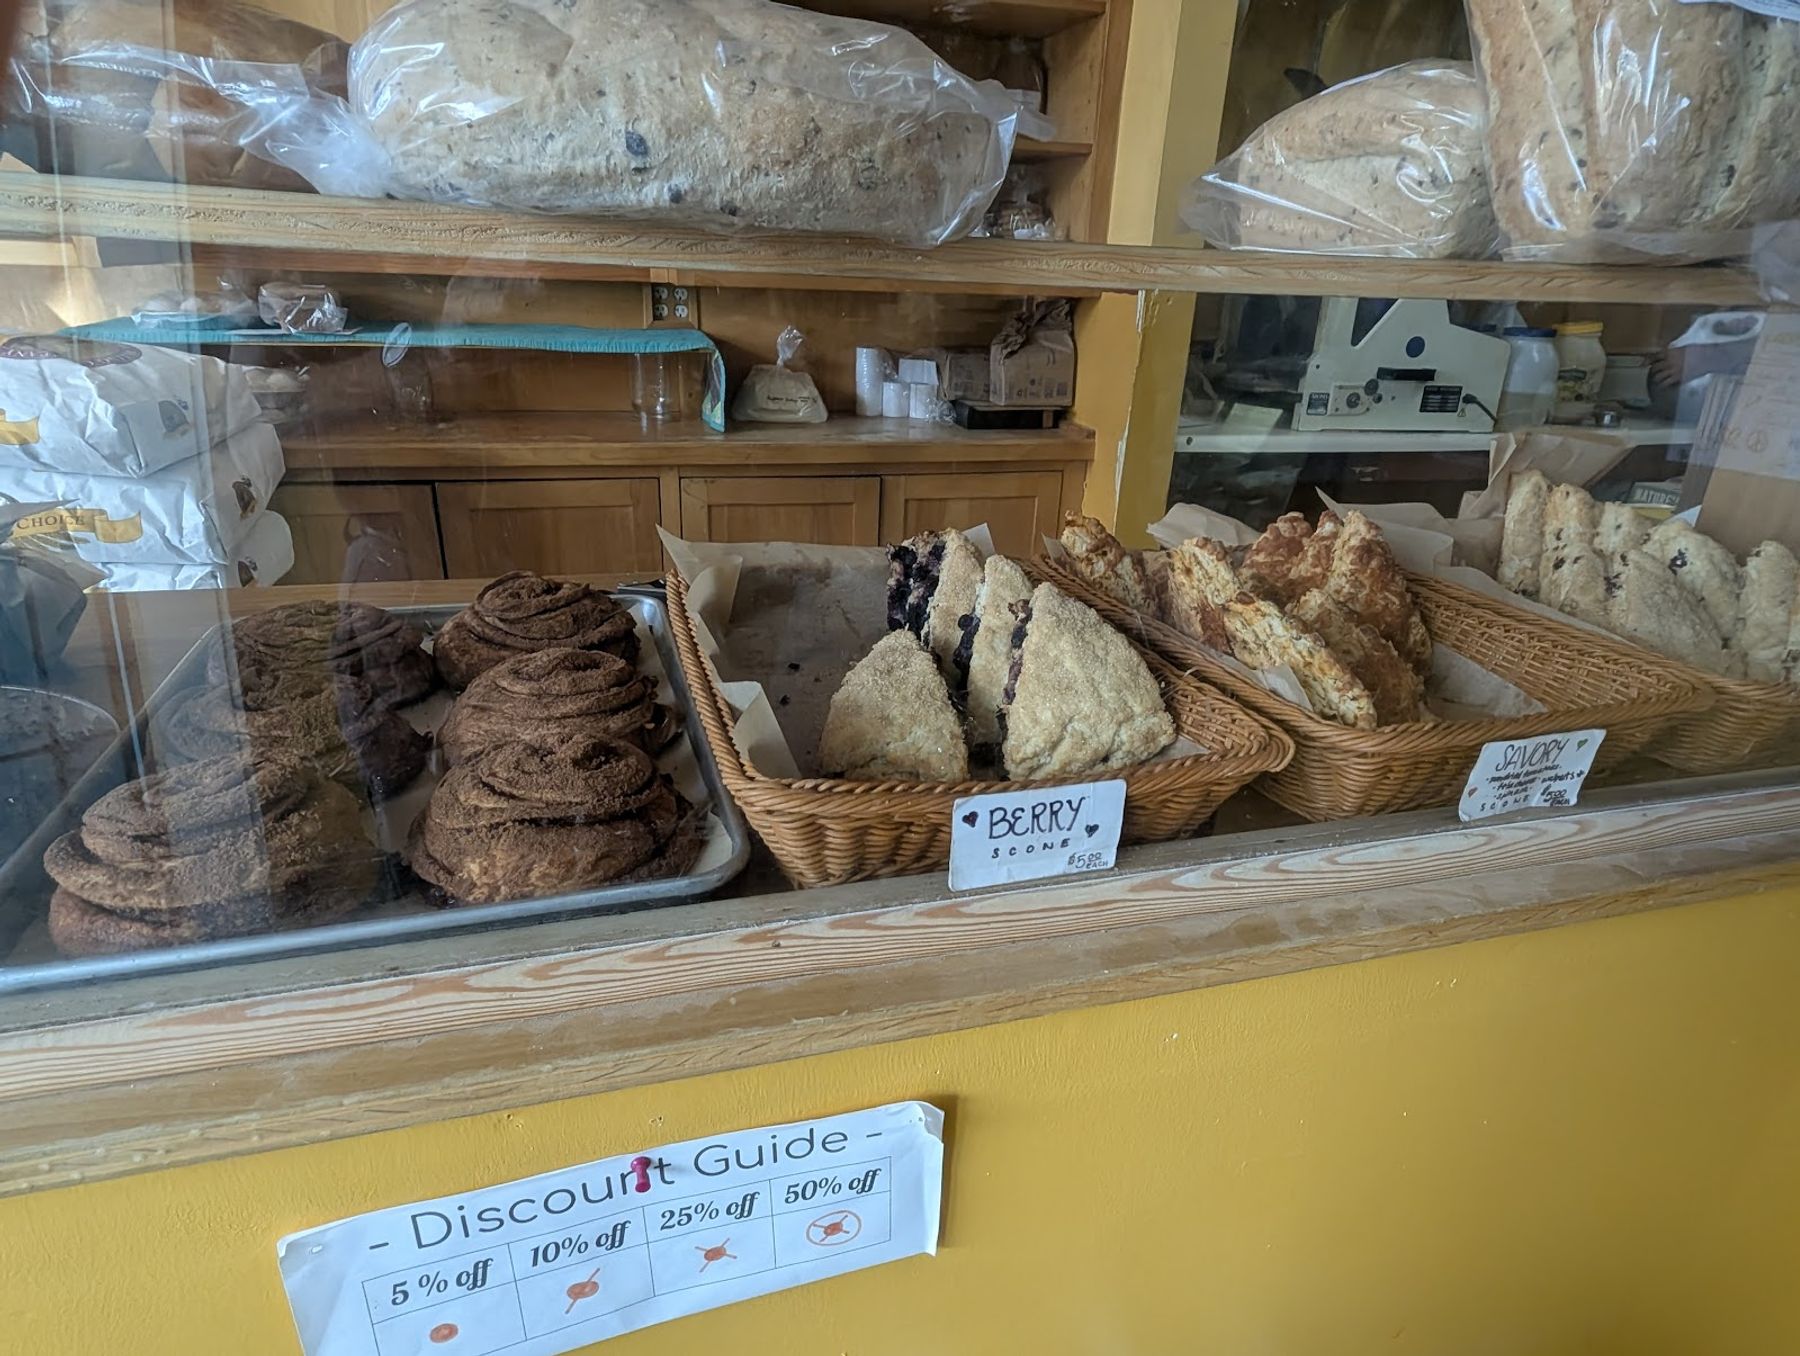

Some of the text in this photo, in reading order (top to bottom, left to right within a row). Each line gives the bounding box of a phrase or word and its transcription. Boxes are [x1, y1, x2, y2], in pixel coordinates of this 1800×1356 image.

[16, 514, 86, 530] CHOICE
[1495, 738, 1570, 772] SAVORY
[988, 796, 1086, 840] BERRY
[991, 837, 1071, 859] SCONE
[410, 1156, 675, 1249] Discount
[693, 1127, 849, 1177] Guide
[784, 1168, 882, 1204] 50% off
[659, 1191, 760, 1232] 25% off
[530, 1219, 632, 1268] 10% off
[455, 1257, 494, 1291] off
